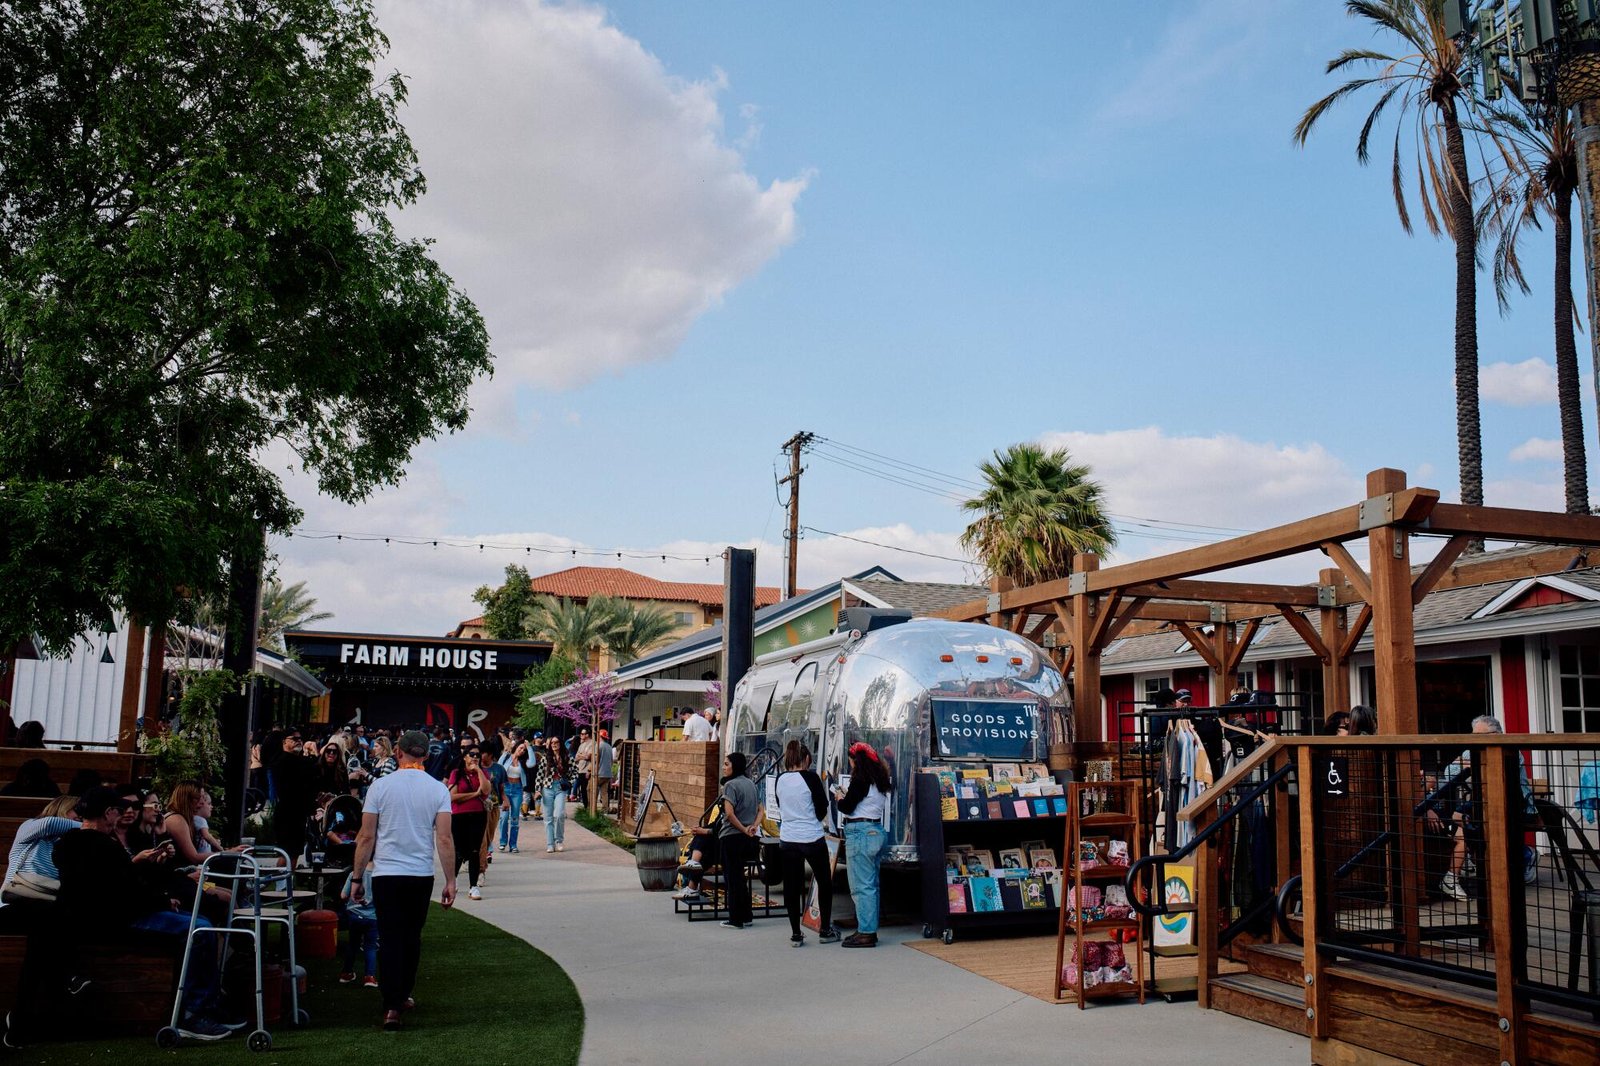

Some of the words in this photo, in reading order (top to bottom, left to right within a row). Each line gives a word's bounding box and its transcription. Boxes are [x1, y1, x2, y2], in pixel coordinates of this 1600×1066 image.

[340, 643, 409, 667] FARM
[419, 647, 498, 671] HOUSE
[644, 678, 654, 690] D
[1023, 705, 1039, 717] 114
[951, 713, 1006, 725] GOODS
[1015, 716, 1025, 725] &
[941, 727, 1039, 740] PROVISIONS
